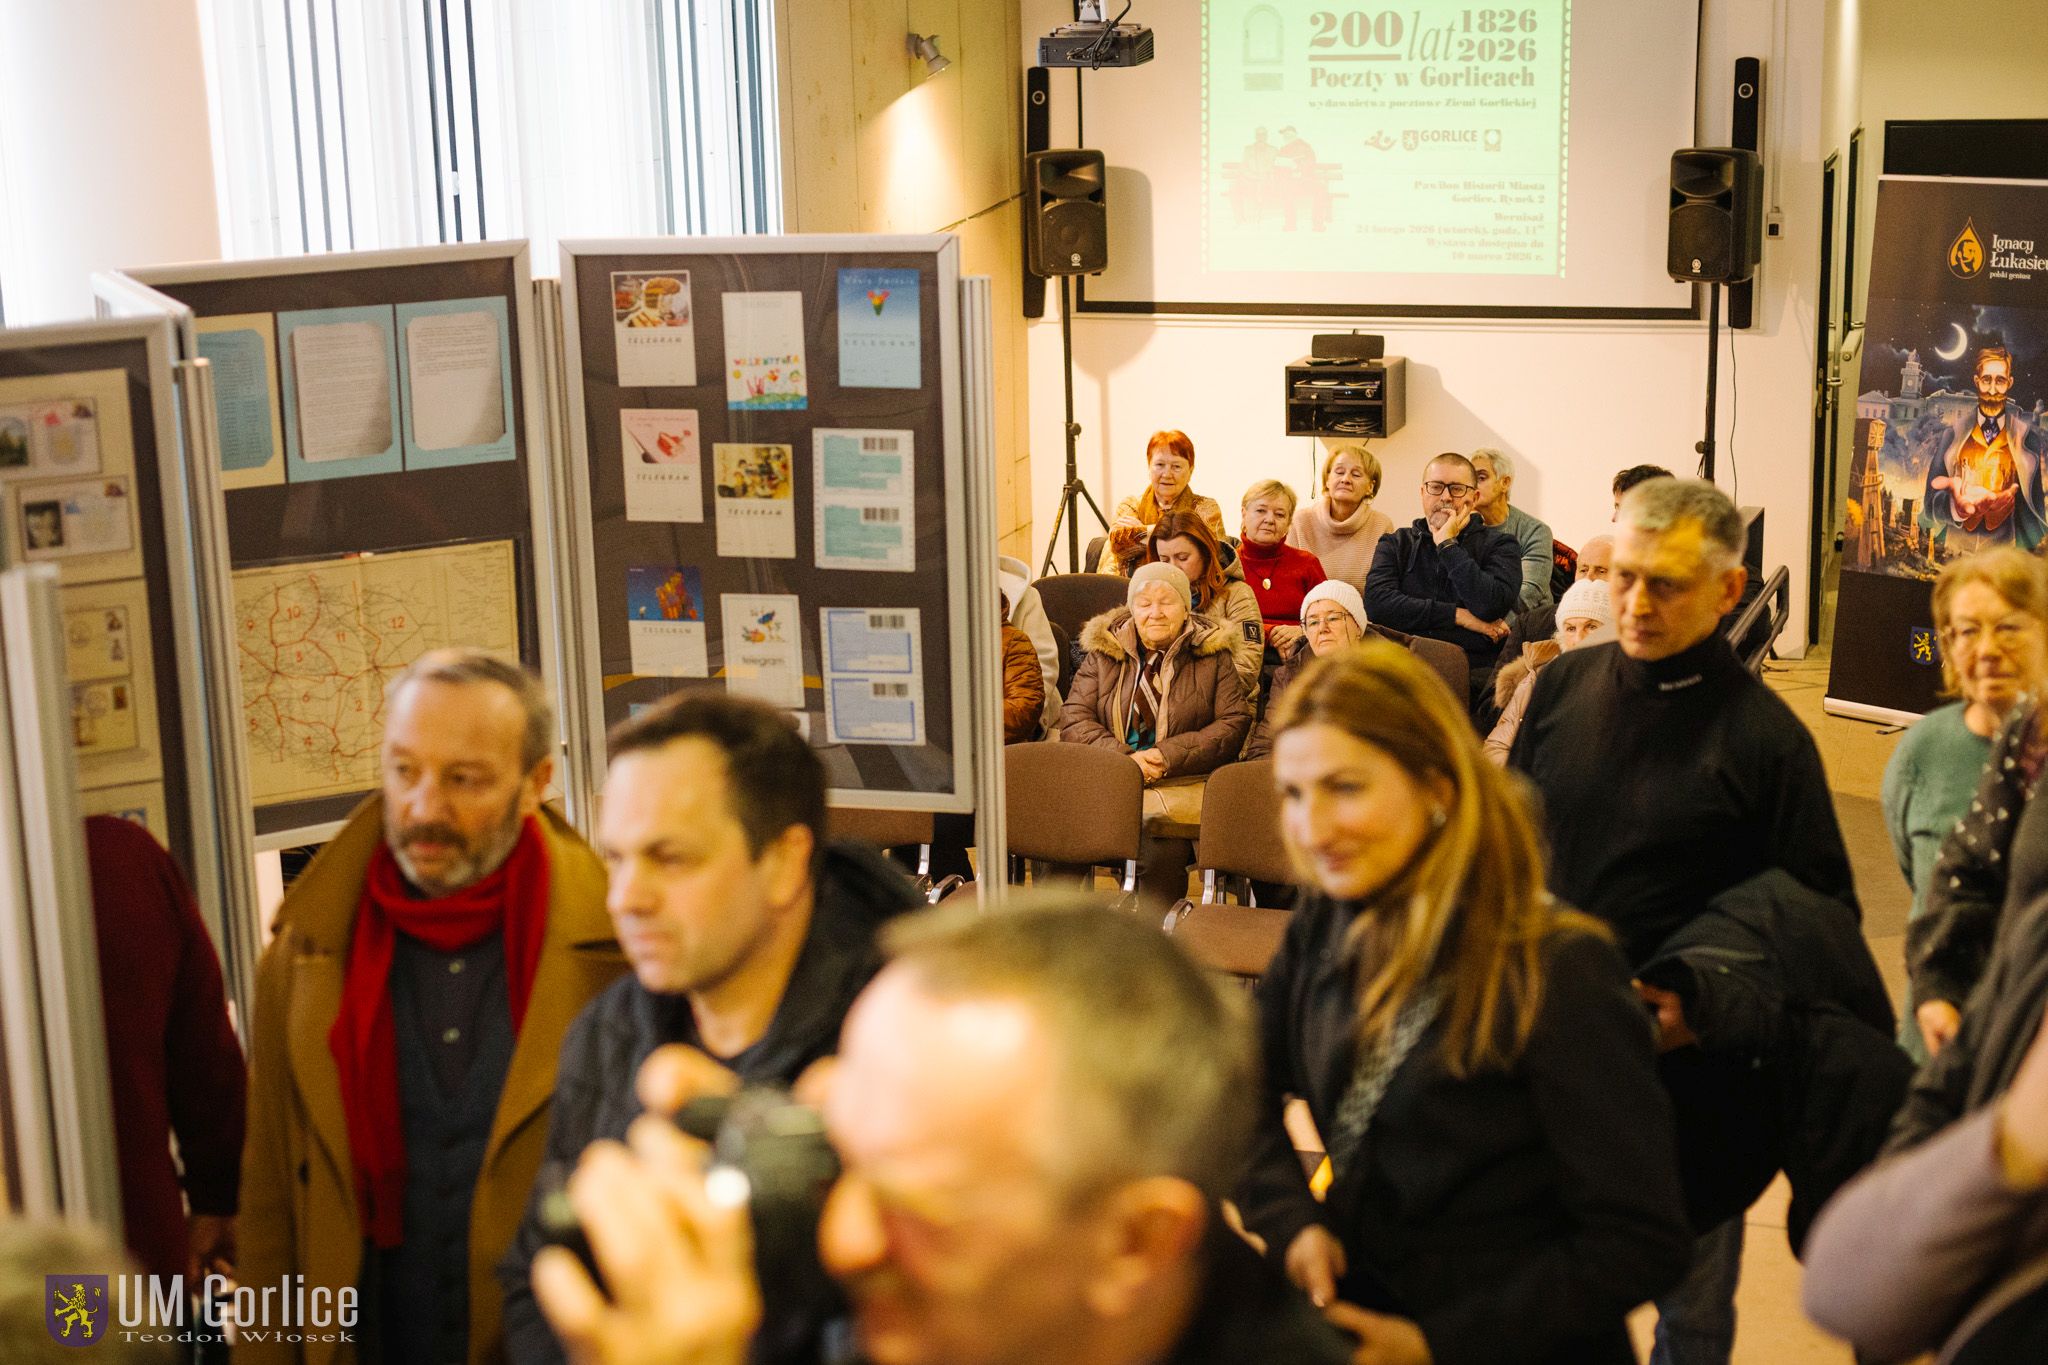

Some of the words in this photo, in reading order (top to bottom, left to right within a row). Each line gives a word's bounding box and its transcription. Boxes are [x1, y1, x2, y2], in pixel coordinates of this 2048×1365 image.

[1460, 8, 1538, 33] 1826
[1309, 10, 1404, 48] 200
[1407, 10, 1456, 62] lat
[1457, 38, 1538, 62] 2026
[1310, 66, 1386, 92] Poczty
[1393, 70, 1413, 87] w
[1420, 66, 1535, 88] Gorlicach
[1308, 98, 1387, 110] wydawnictwa
[1445, 98, 1476, 108] Ziemi
[1479, 97, 1537, 110] Gorlickiej
[1420, 129, 1479, 143] GORLICE
[1538, 194, 1545, 204] 2
[1992, 234, 2034, 254] Ignacy
[1989, 270, 2008, 279] polski
[2008, 272, 2032, 280] geniusz
[285, 605, 302, 621] 10
[389, 615, 406, 630] 12
[742, 656, 786, 667] telegram
[355, 699, 363, 712] 2
